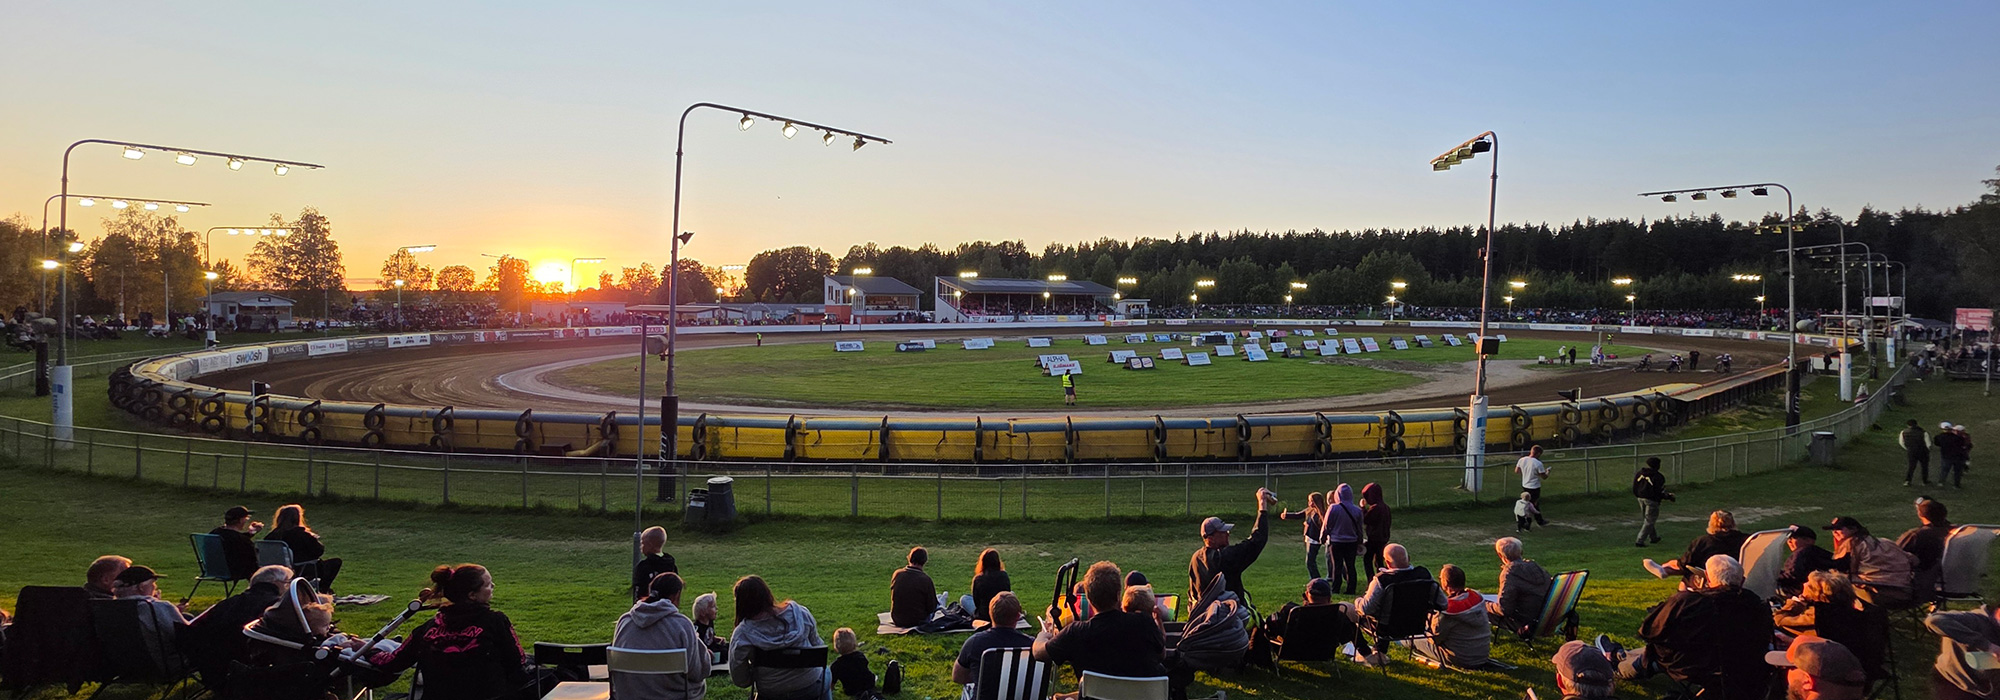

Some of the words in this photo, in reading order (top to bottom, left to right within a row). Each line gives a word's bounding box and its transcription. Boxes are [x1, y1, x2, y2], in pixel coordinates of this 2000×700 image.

[272, 346, 289, 354] KUMLA
[289, 345, 304, 353] HOTEL
[236, 349, 262, 364] swoosh
[1046, 355, 1065, 363] ALPHA
